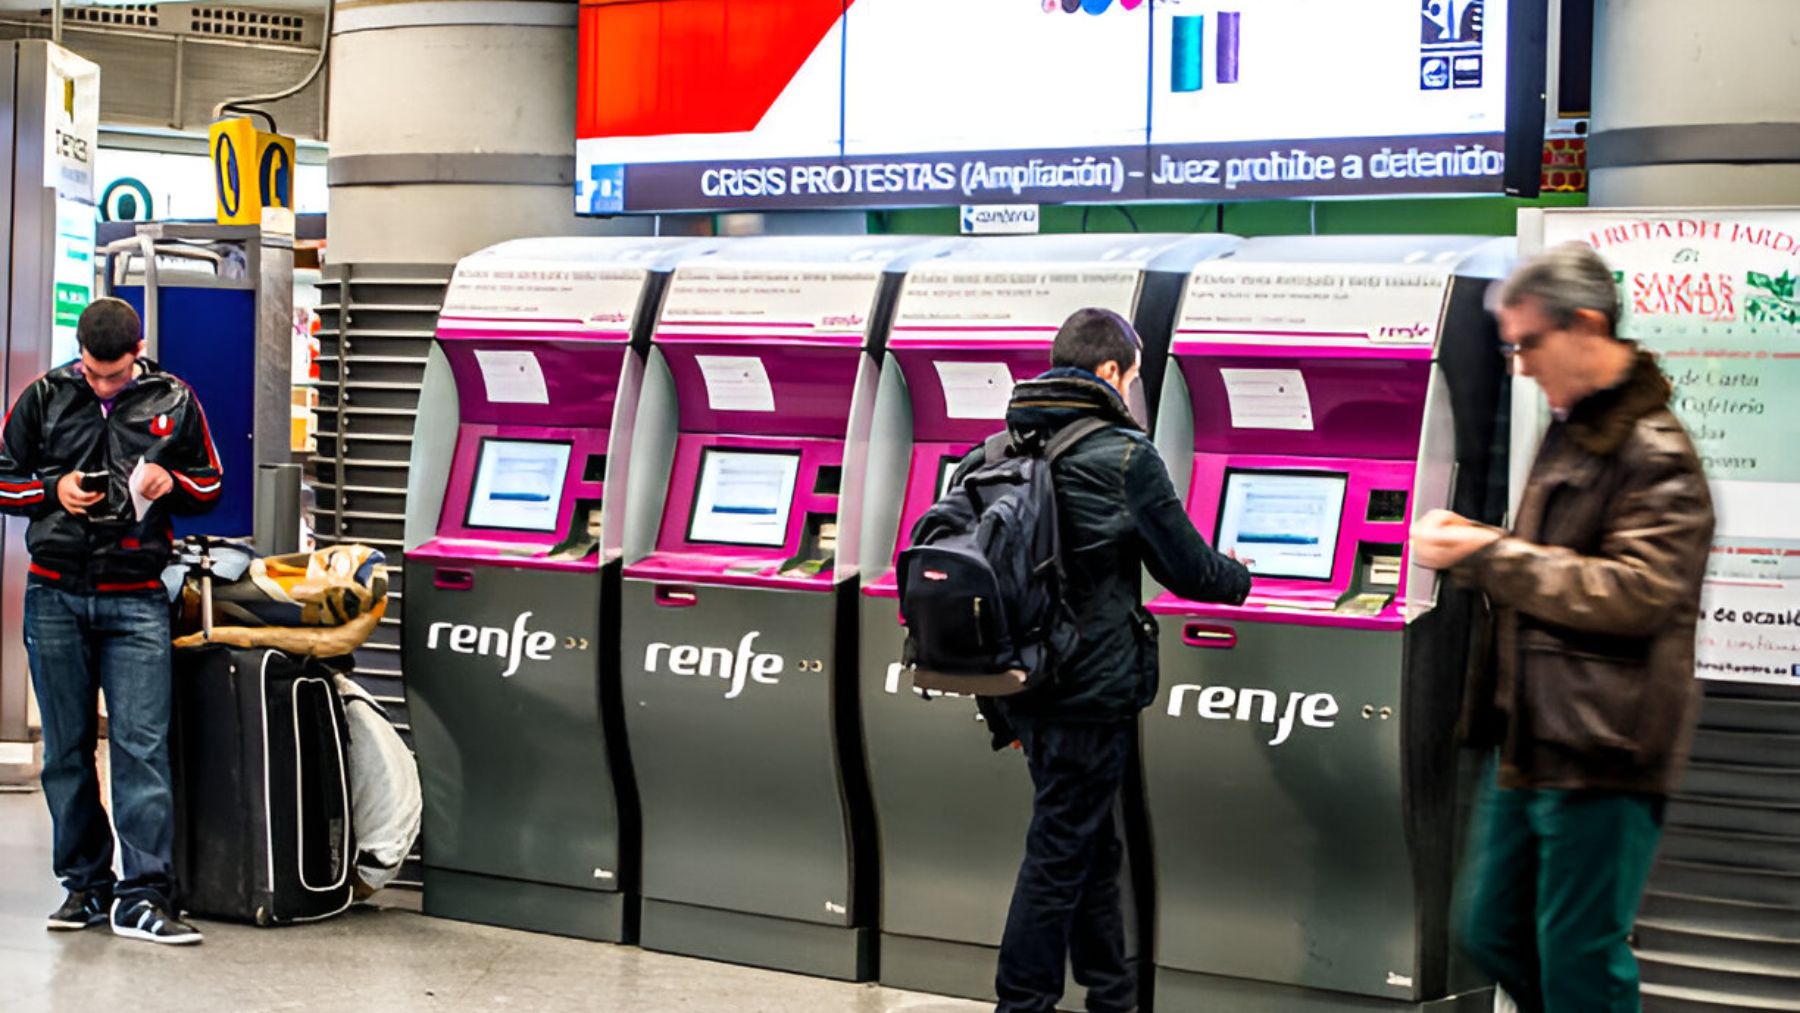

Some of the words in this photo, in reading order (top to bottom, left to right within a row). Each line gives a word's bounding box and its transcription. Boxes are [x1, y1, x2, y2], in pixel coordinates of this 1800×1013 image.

[701, 167, 786, 197] CRISIS
[790, 161, 956, 194] PROTESTAS
[961, 155, 1125, 195] (Ampliación)
[1151, 154, 1219, 185] Juez
[1341, 154, 1363, 179] a
[427, 611, 556, 677] renfe
[644, 631, 784, 698] renfe
[1166, 683, 1339, 746] renfe
